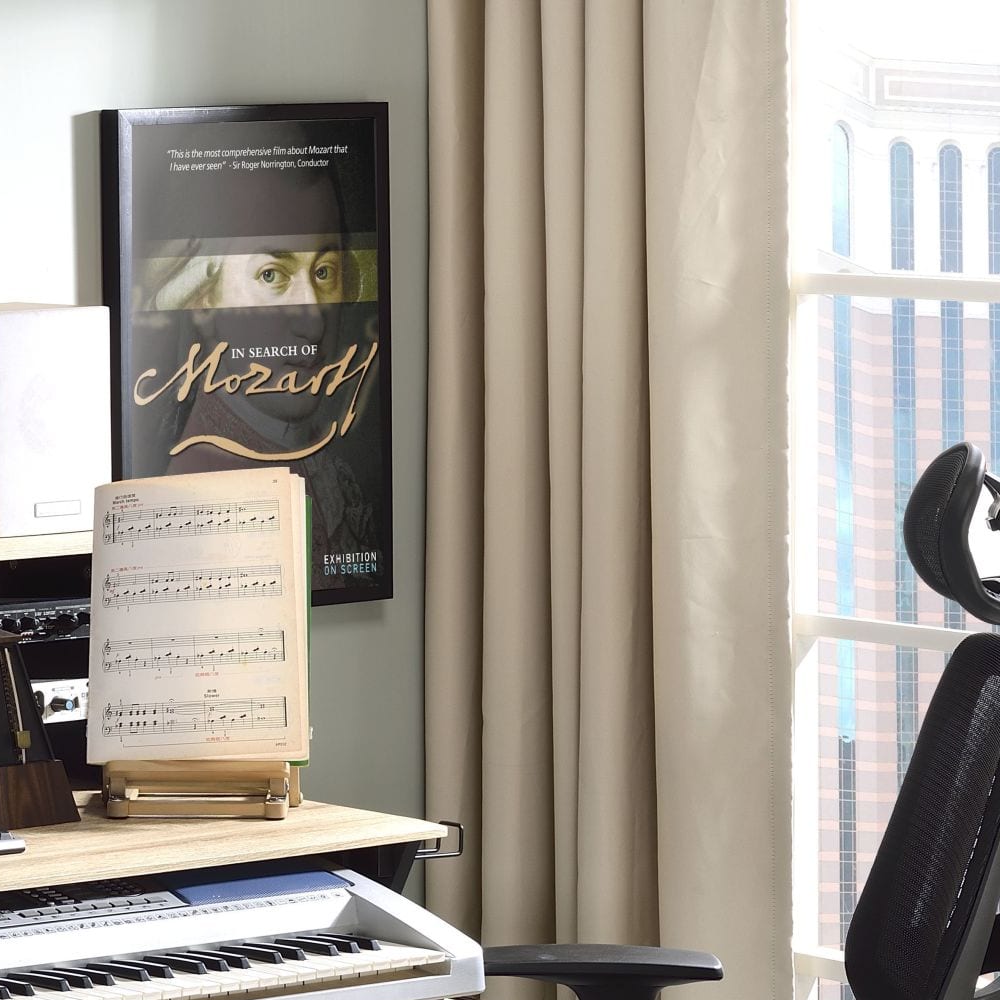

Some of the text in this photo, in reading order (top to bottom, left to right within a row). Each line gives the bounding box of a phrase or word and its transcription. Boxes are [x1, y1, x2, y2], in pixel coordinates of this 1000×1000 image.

[166, 144, 348, 159] "This is the most comprehensive film about Mozart that
[173, 162, 190, 171] have
[190, 163, 206, 171] ever
[232, 161, 241, 170] Sir
[241, 160, 260, 171] Roger
[260, 159, 296, 171] Norrington,
[297, 158, 329, 168] Conductor
[231, 344, 318, 359] IN SEARCH OF
[133, 341, 379, 437] Mozart
[323, 551, 377, 565] EXHIBITION
[324, 562, 377, 576] ON SCREEN
